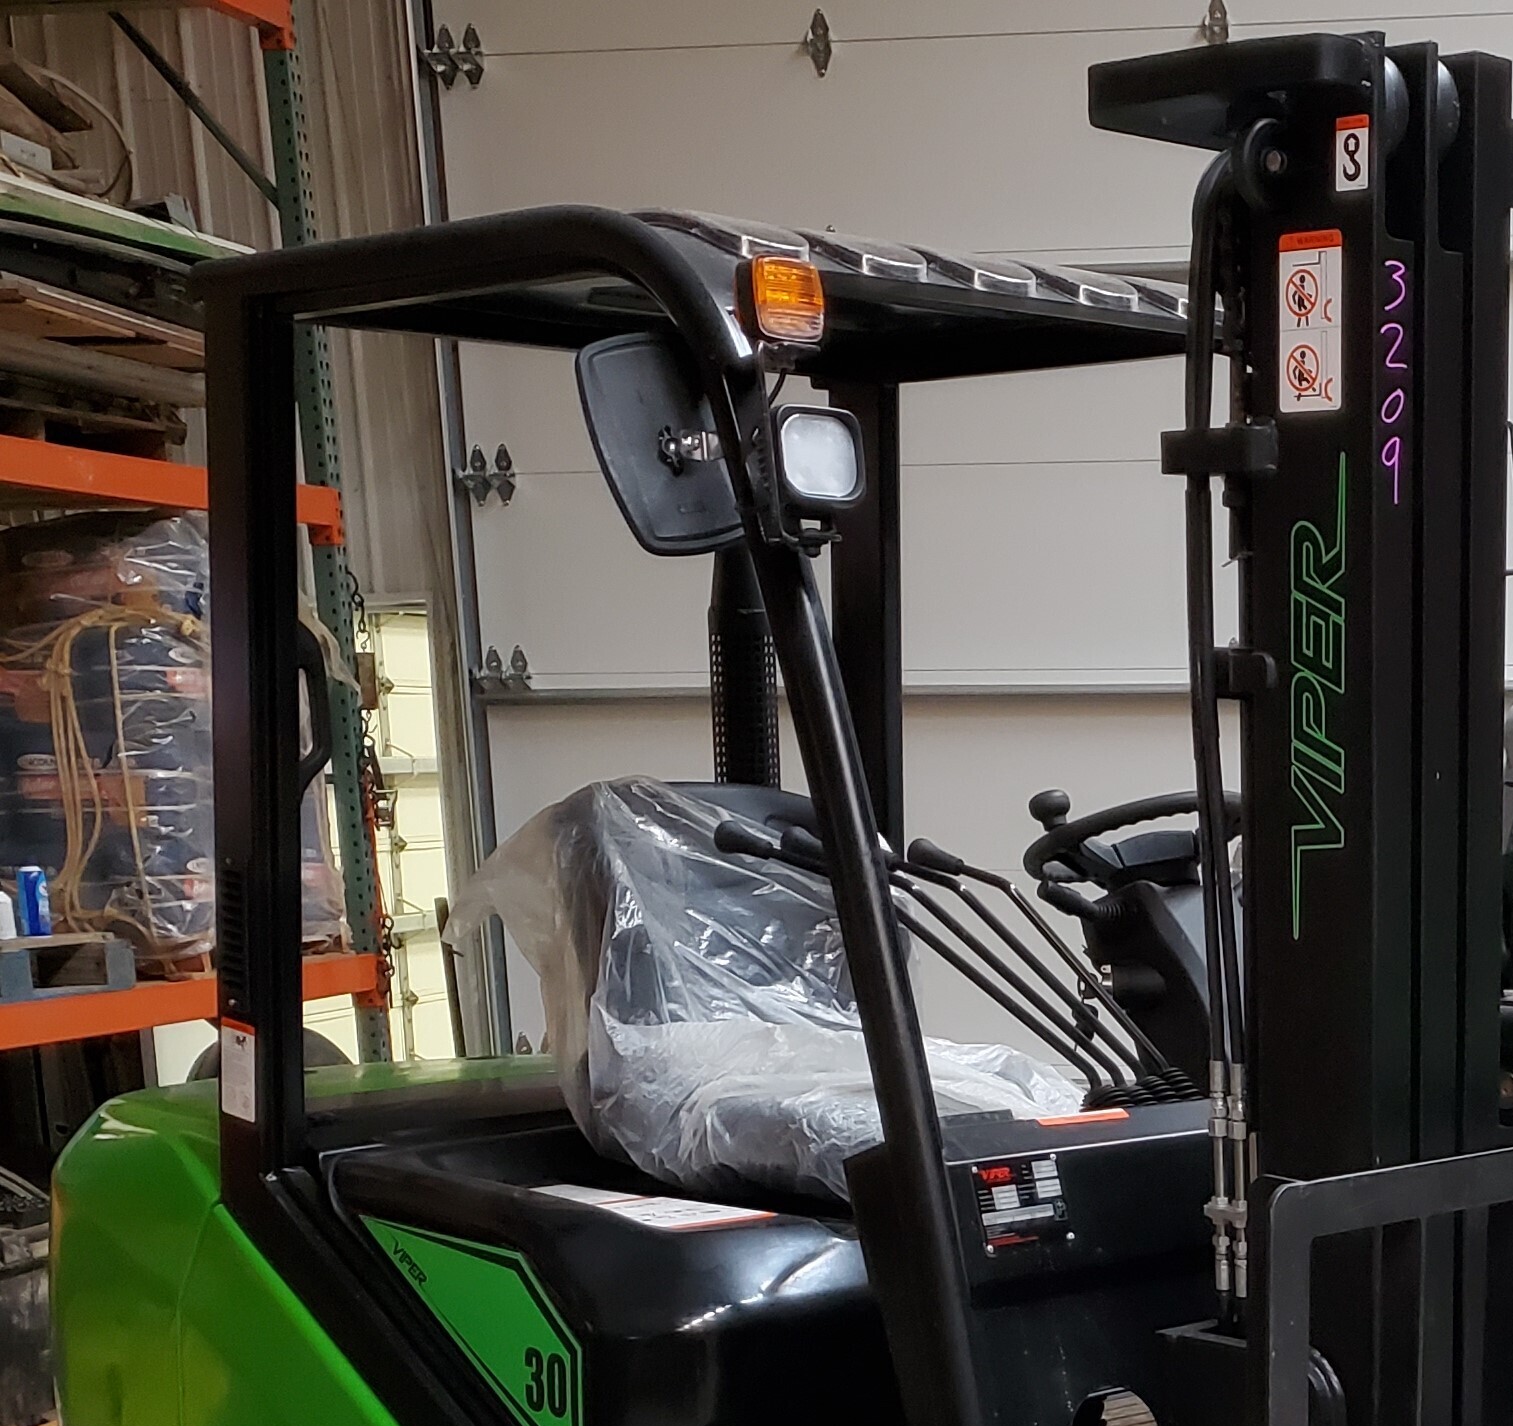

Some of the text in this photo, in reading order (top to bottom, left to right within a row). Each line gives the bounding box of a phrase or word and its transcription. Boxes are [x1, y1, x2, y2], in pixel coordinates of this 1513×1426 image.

[1380, 259, 1408, 505] 3209
[1291, 452, 1346, 940] VIPER
[389, 1232, 429, 1289] VIPER
[524, 1347, 569, 1419] 30
